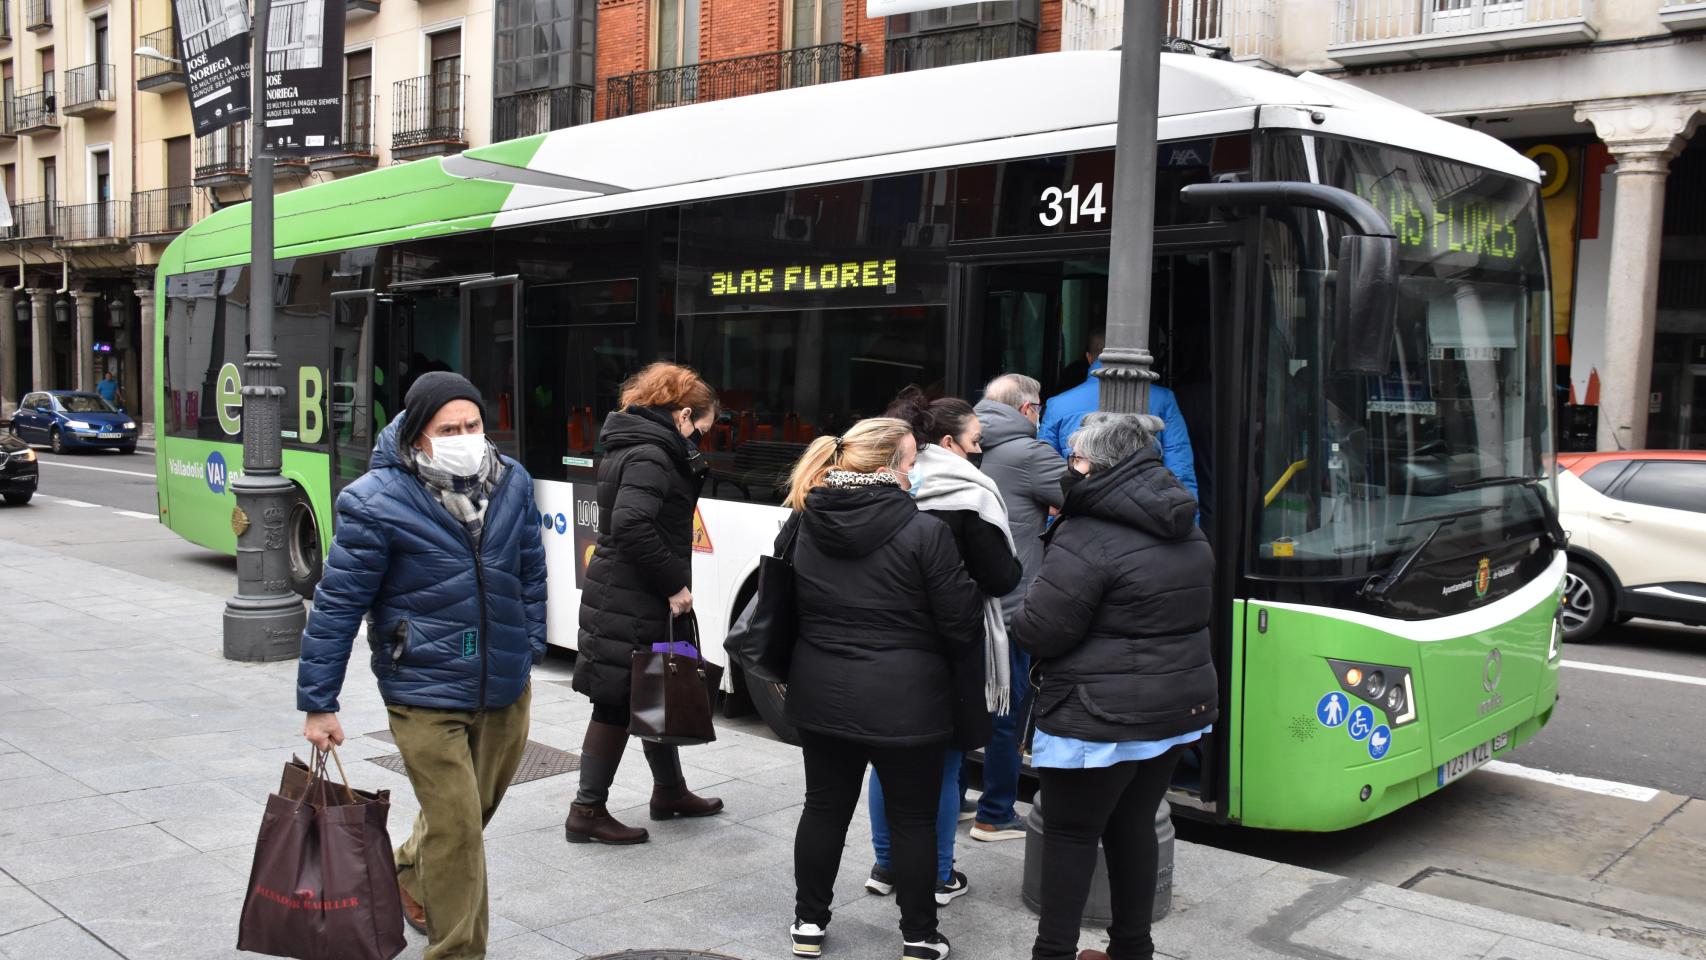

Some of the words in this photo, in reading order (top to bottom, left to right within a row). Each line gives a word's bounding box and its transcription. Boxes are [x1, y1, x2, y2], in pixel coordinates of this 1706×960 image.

[187, 52, 208, 73] JOSÉ
[189, 56, 232, 84] NORIEGA
[192, 85, 214, 98] AUNQUE
[215, 80, 226, 88] SEA
[226, 74, 239, 83] UNA
[266, 72, 282, 88] JOSÉ
[266, 86, 298, 100] NORIEGA
[1039, 182, 1106, 227] 314
[784, 259, 896, 291] FLORES
[168, 457, 204, 480] Valladolid
[206, 462, 225, 486] VA!
